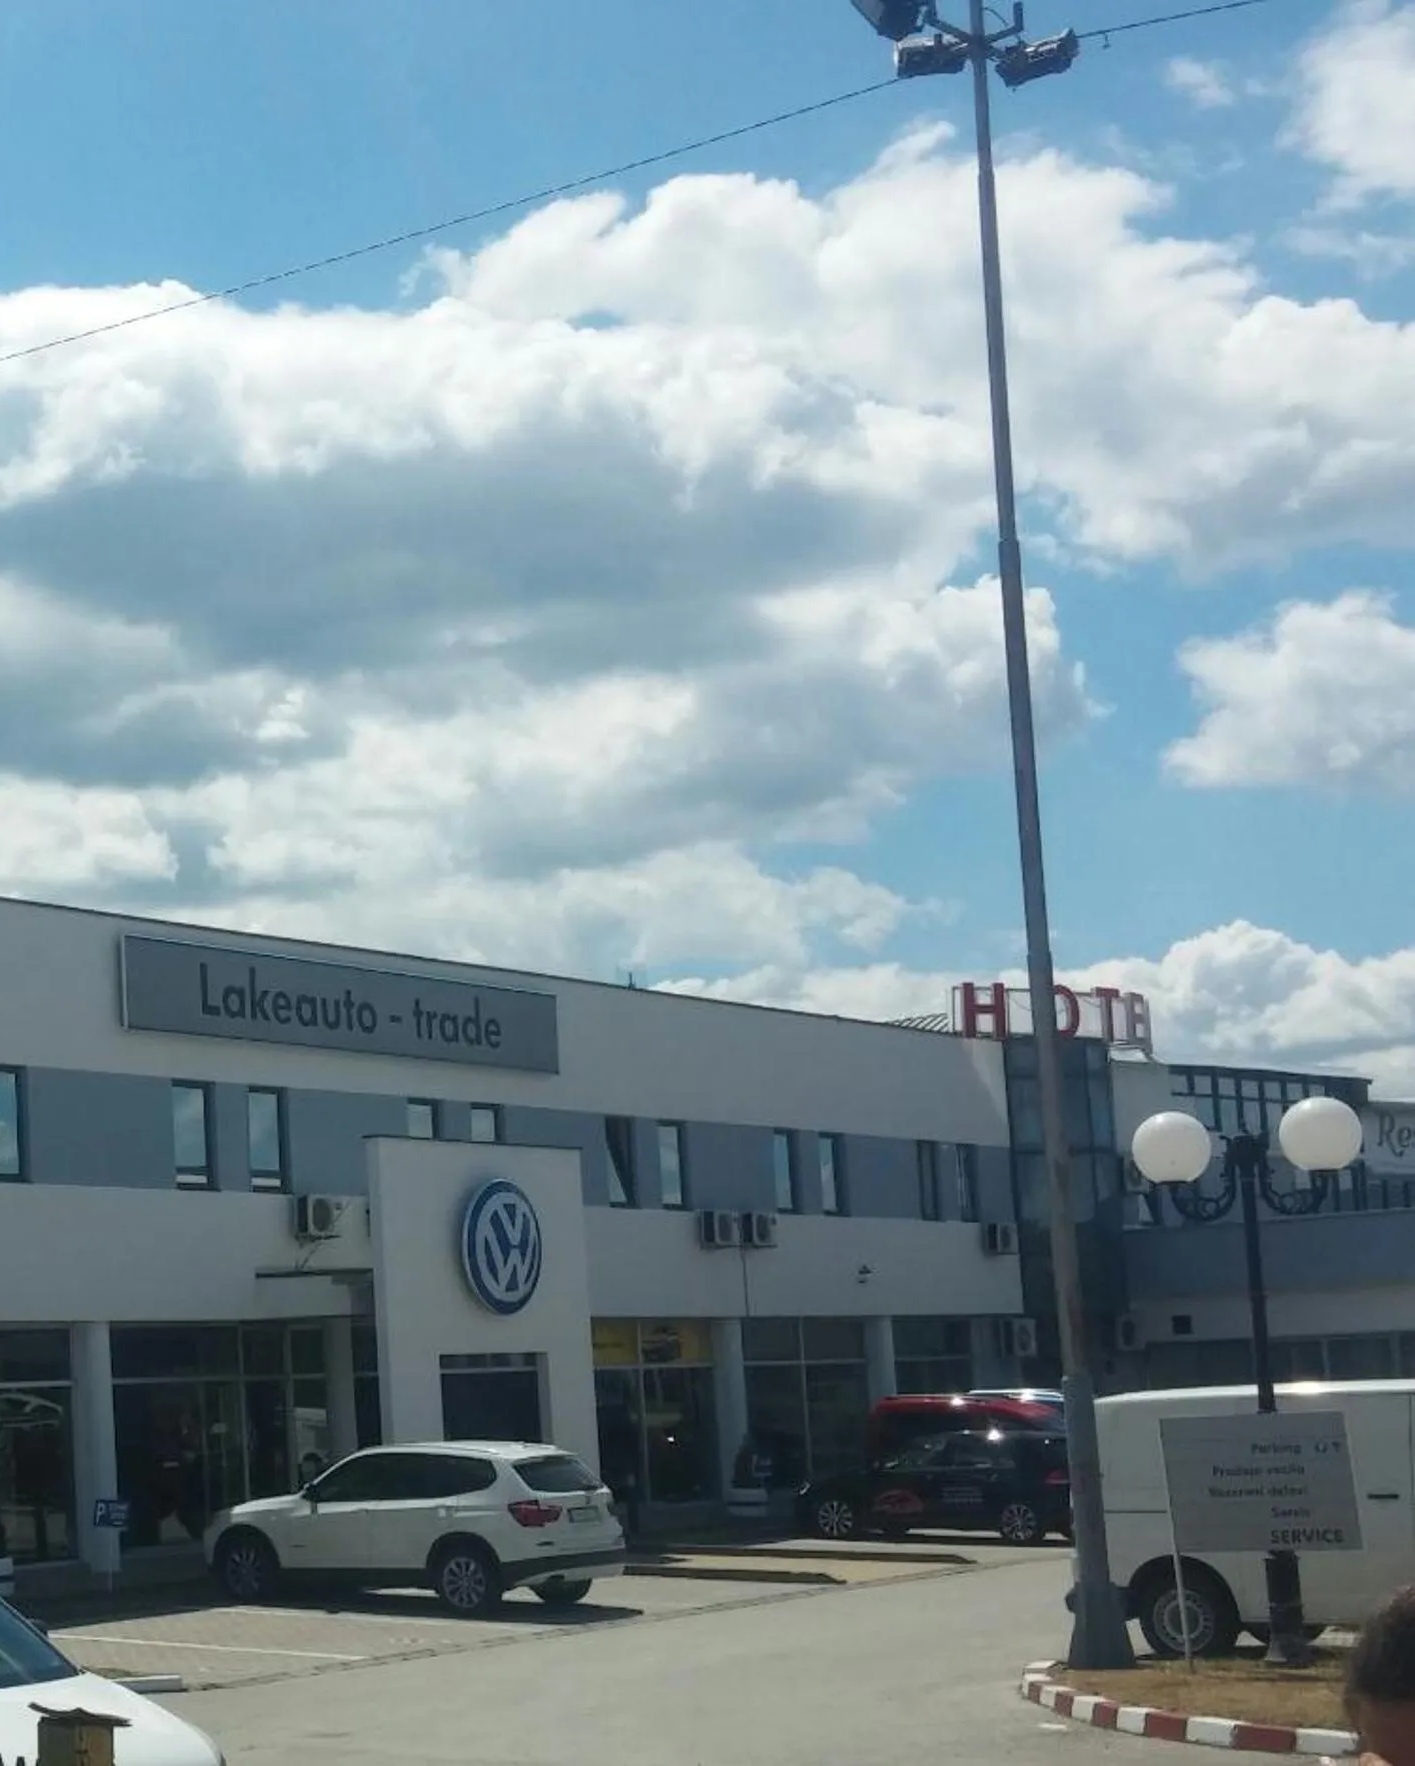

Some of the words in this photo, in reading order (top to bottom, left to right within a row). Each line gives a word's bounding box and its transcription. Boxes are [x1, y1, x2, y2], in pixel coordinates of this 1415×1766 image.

[199, 962, 378, 1034] Lakeauto
[412, 996, 503, 1049] trade
[1270, 1528, 1345, 1544] SERVICE
